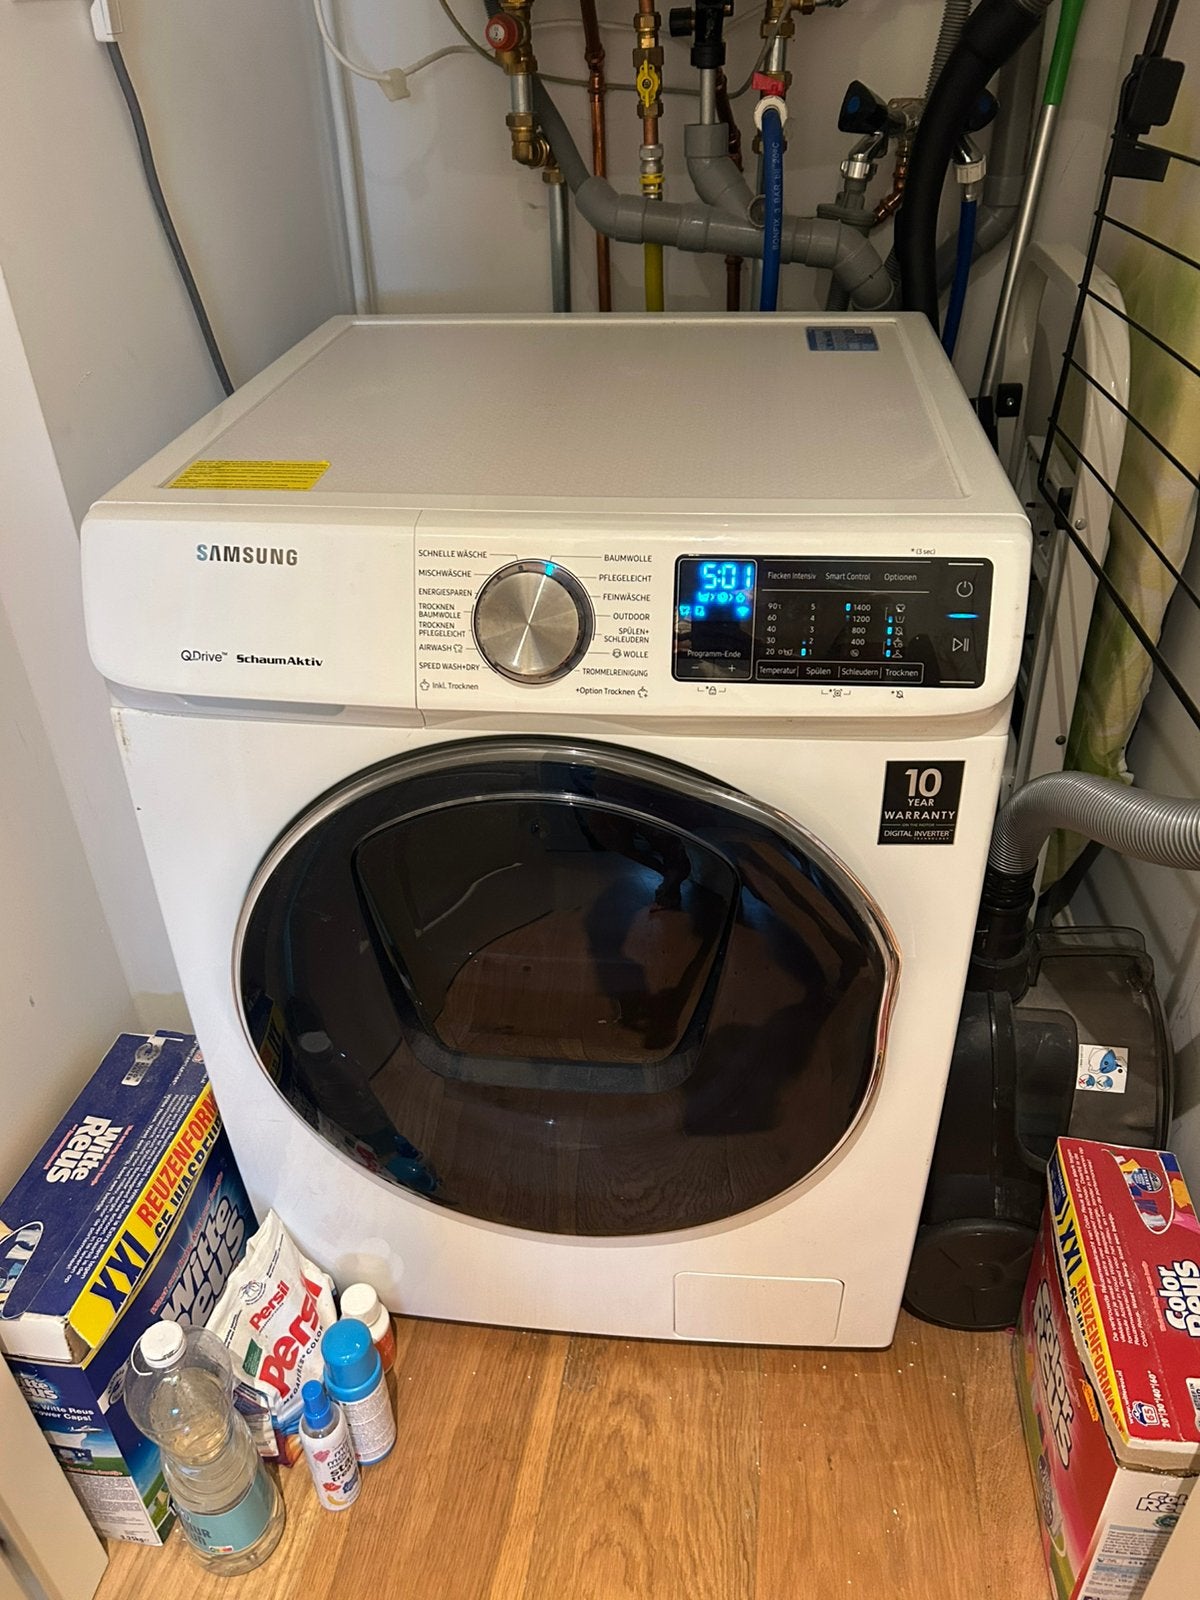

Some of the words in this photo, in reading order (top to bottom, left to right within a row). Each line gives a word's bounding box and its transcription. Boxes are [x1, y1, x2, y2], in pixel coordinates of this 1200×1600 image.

[196, 544, 298, 566] SAMSUNG
[418, 550, 455, 558] SCHNELLE
[457, 550, 487, 559] WÄSCHE
[604, 554, 652, 563] BAUMWOLLE
[418, 569, 471, 578] MISCHWÄSCHE
[599, 574, 652, 582] PFLEGELEICHT
[703, 562, 752, 590] 5:01
[767, 571, 791, 580] Flecken
[792, 571, 817, 580] Intensiv
[825, 572, 846, 581] Smart
[847, 572, 871, 581] Control
[884, 573, 917, 582] Optionen
[418, 588, 473, 596] ENERGIESPAREN
[603, 593, 651, 602] FEINWÄSCHE
[811, 603, 816, 611] 5
[418, 611, 461, 619] BAUMWOLLE
[613, 613, 650, 621] OUTDOOR
[418, 621, 455, 629] TROCKNEN
[618, 626, 649, 635] SPÜLEN+
[604, 635, 649, 644] SCHLEUDERN
[623, 650, 648, 658] WOLLE
[687, 649, 741, 660] Programm-Ende
[442, 663, 480, 671] WASH+DRY
[583, 669, 648, 677] TROMMELREINIGUNG
[759, 666, 797, 677] Temperatur
[806, 666, 831, 677] Spülen
[841, 667, 879, 677] Schleudern
[885, 668, 918, 678] Trocknen
[432, 681, 447, 690] Inkl.
[448, 682, 479, 690] Trocknen
[576, 687, 602, 695] +Option
[603, 687, 635, 696] Trocknen
[905, 768, 942, 797] 10
[884, 811, 956, 820] WARRANTY
[46, 1115, 113, 1184] Reus
[68, 1124, 123, 1182] Witte
[160, 1196, 234, 1320] Witte
[1159, 1266, 1191, 1332] Color
[249, 1280, 290, 1331] Persil
[41, 1404, 67, 1414] Witte
[68, 1407, 95, 1416] Reus
[63, 1413, 93, 1422] Caps!
[1143, 1409, 1155, 1422] 65
[1147, 1491, 1189, 1506] Col
